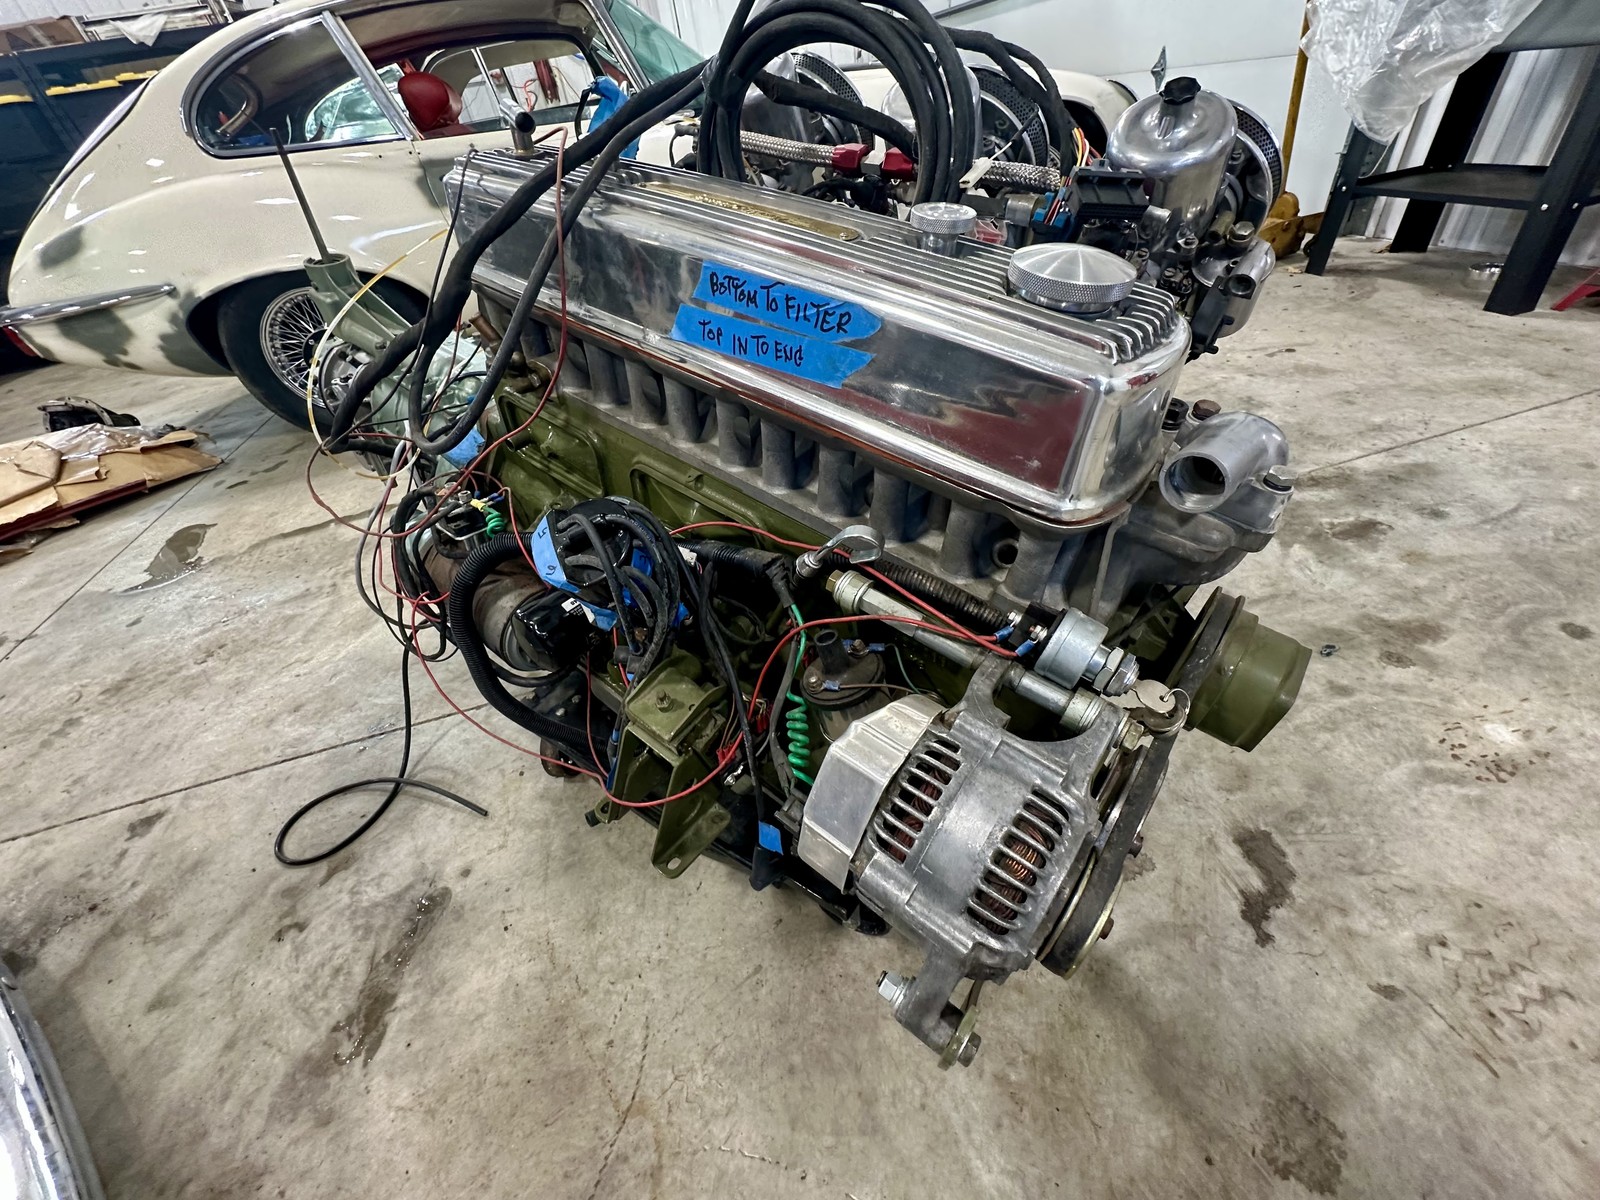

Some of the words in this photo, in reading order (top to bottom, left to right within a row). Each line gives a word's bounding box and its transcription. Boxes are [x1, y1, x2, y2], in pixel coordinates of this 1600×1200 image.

[709, 271, 758, 308] BOTTOM
[760, 281, 785, 312] TO
[785, 293, 851, 334] FILTER
[698, 319, 723, 346] TOP
[774, 340, 804, 367] ENG
